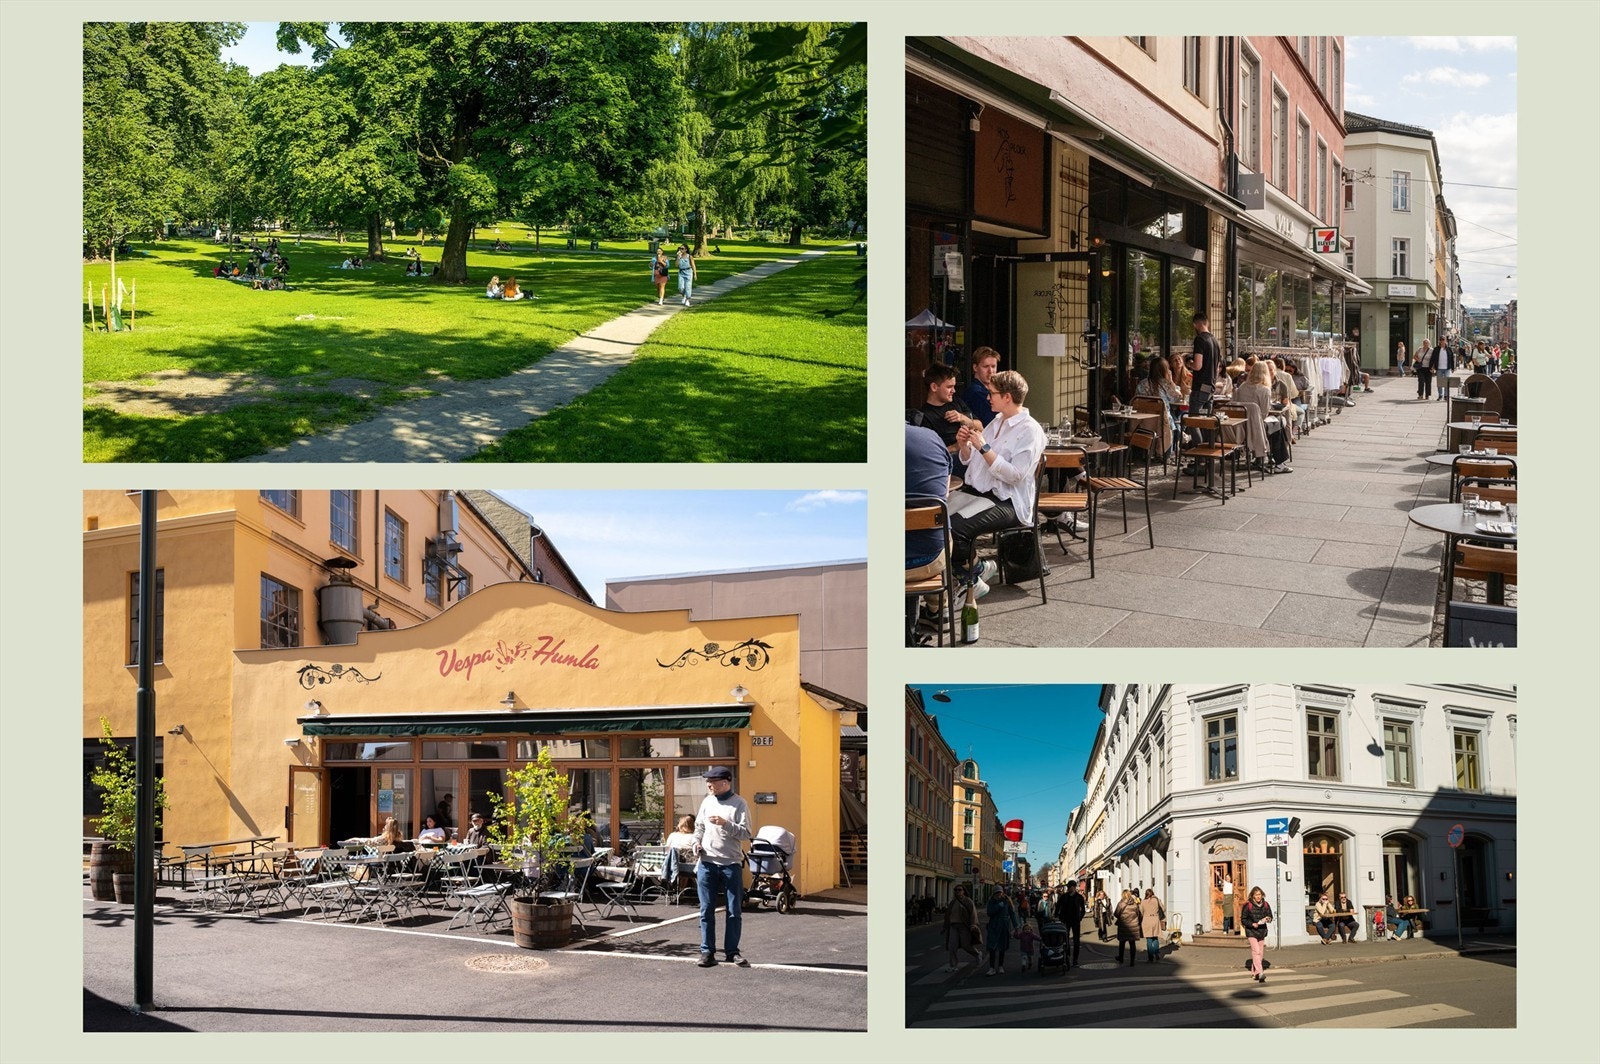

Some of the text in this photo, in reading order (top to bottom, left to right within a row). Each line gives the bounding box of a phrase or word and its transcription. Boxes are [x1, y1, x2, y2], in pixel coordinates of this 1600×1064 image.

[1318, 231, 1335, 253] 7
[436, 636, 600, 681] Vespa Humla
